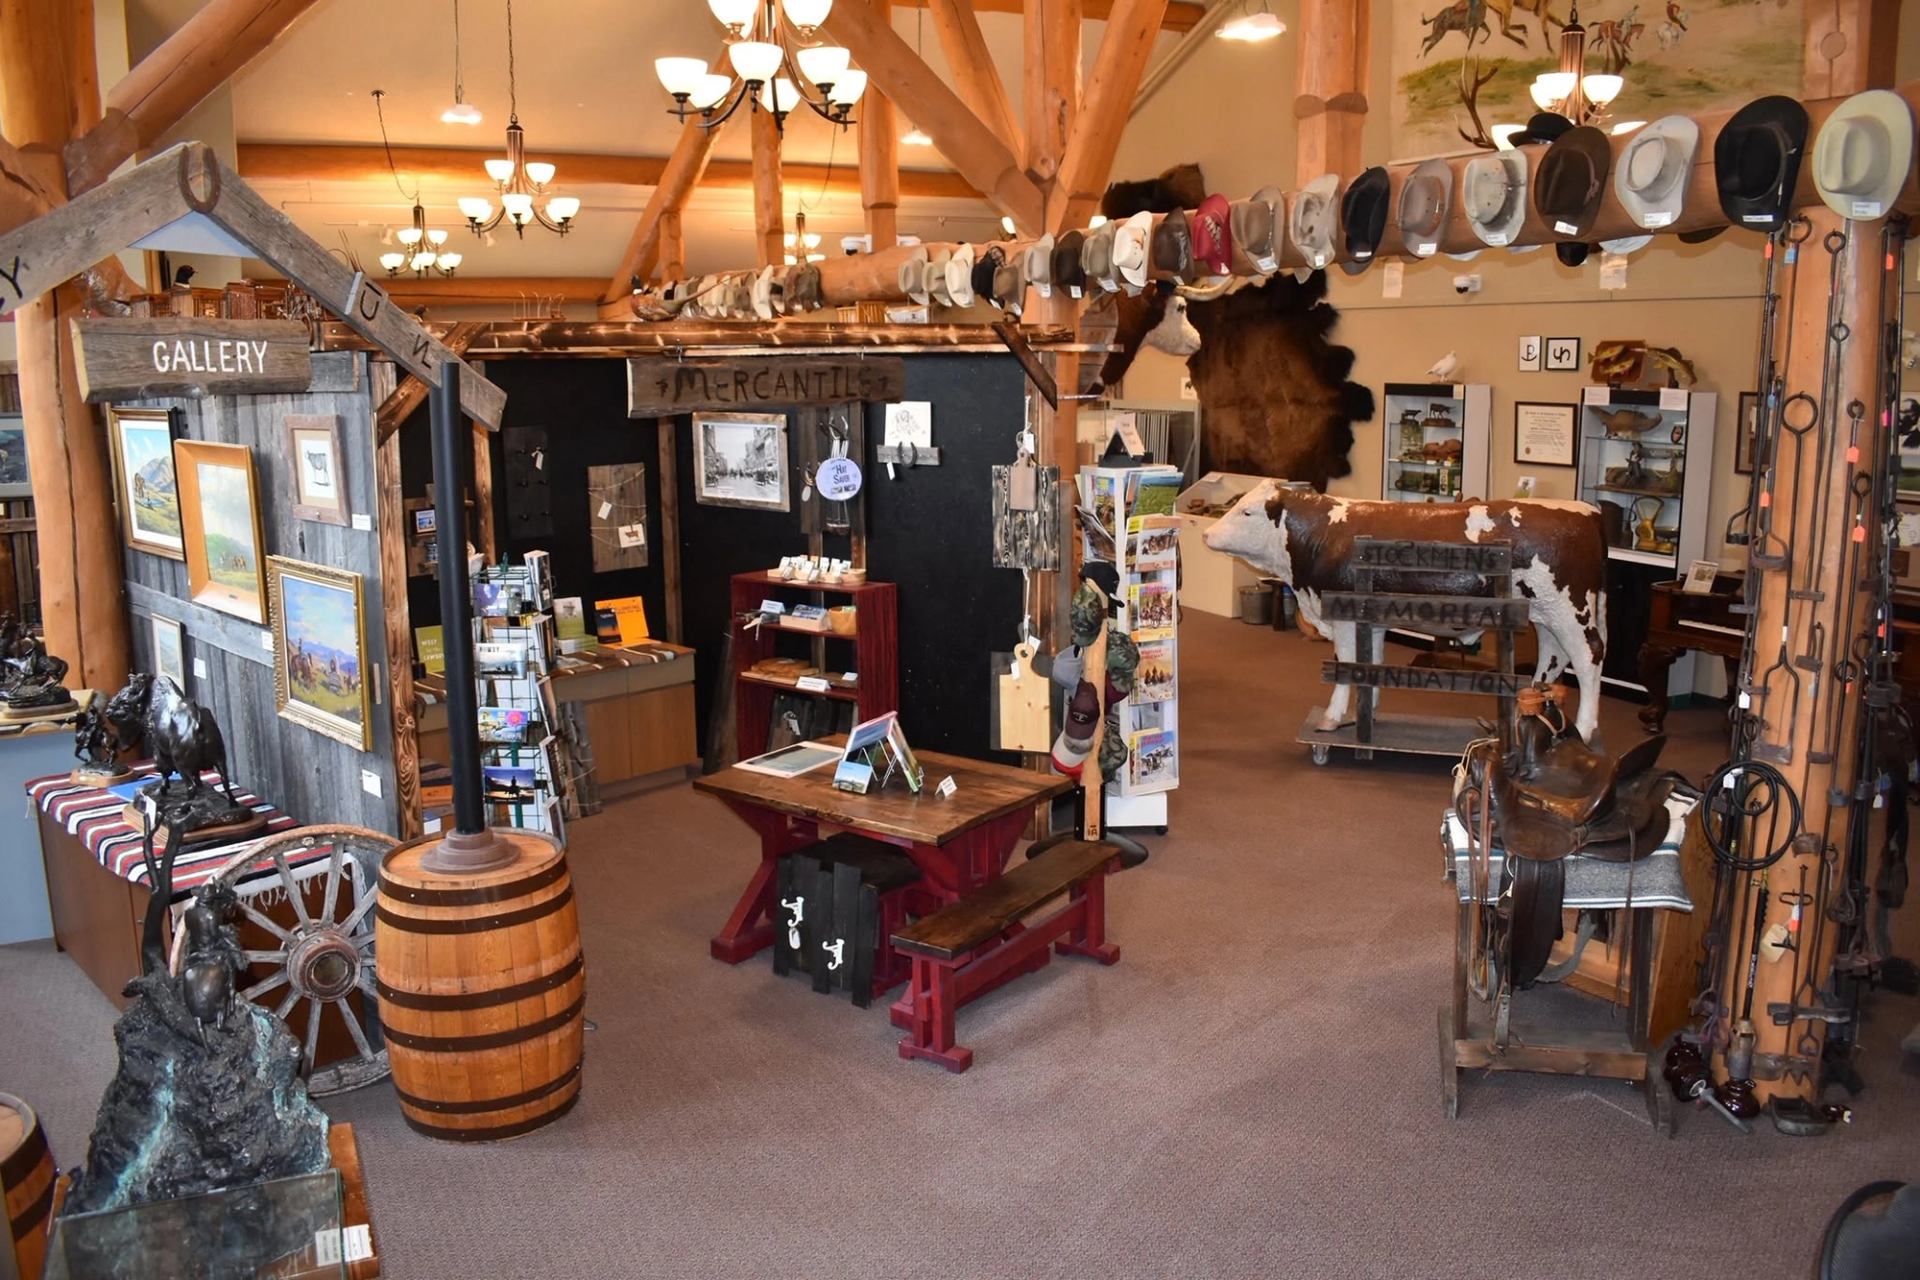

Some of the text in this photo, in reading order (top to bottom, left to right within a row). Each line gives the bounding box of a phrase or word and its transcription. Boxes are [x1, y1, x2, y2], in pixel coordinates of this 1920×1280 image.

[153, 340, 267, 374] GALLERY
[674, 366, 872, 402] MERCANTILE
[1331, 597, 1520, 626] MEMORIAL
[1335, 663, 1519, 695] FOUNDATION
